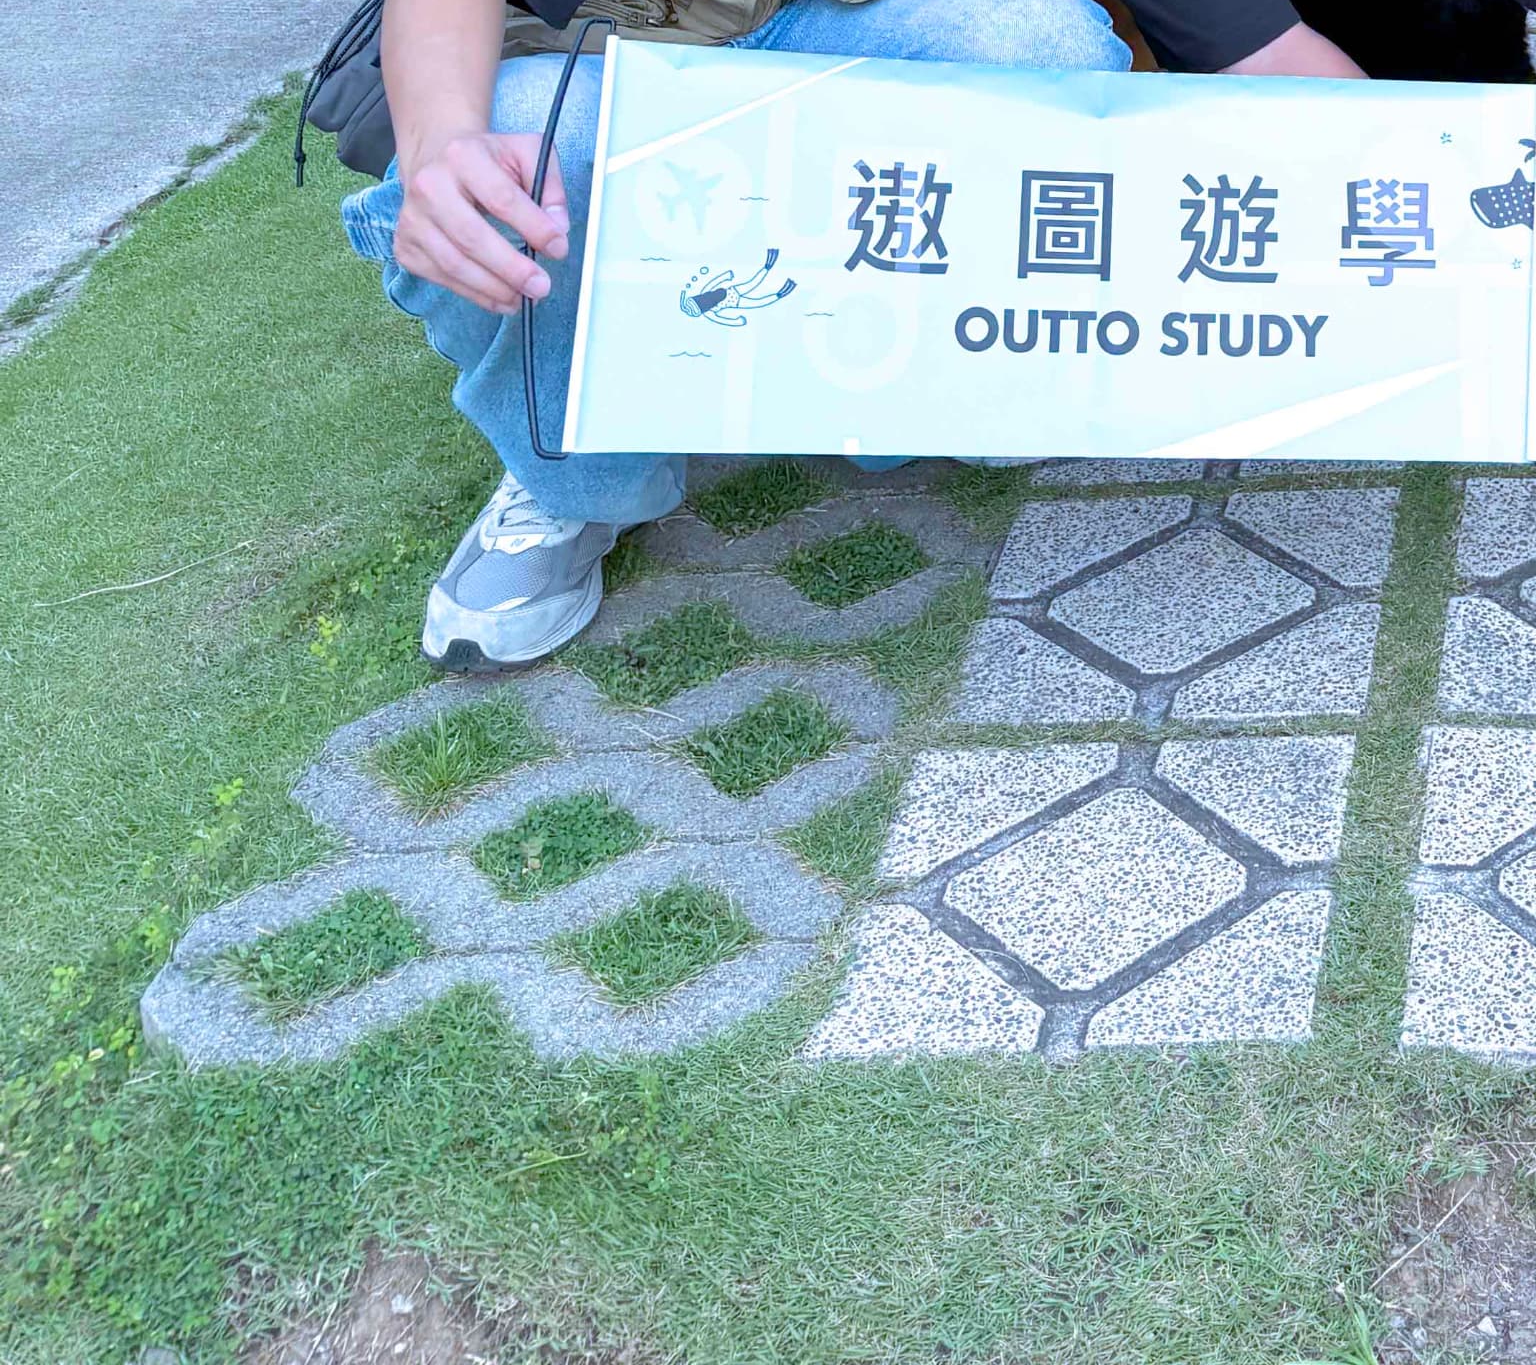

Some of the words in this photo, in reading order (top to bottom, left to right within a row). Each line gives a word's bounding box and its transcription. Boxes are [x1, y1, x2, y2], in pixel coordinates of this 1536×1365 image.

[844, 160, 1437, 287] 遨圖遊學
[954, 305, 1140, 357] OUTTO
[1159, 311, 1329, 358] STUDY
